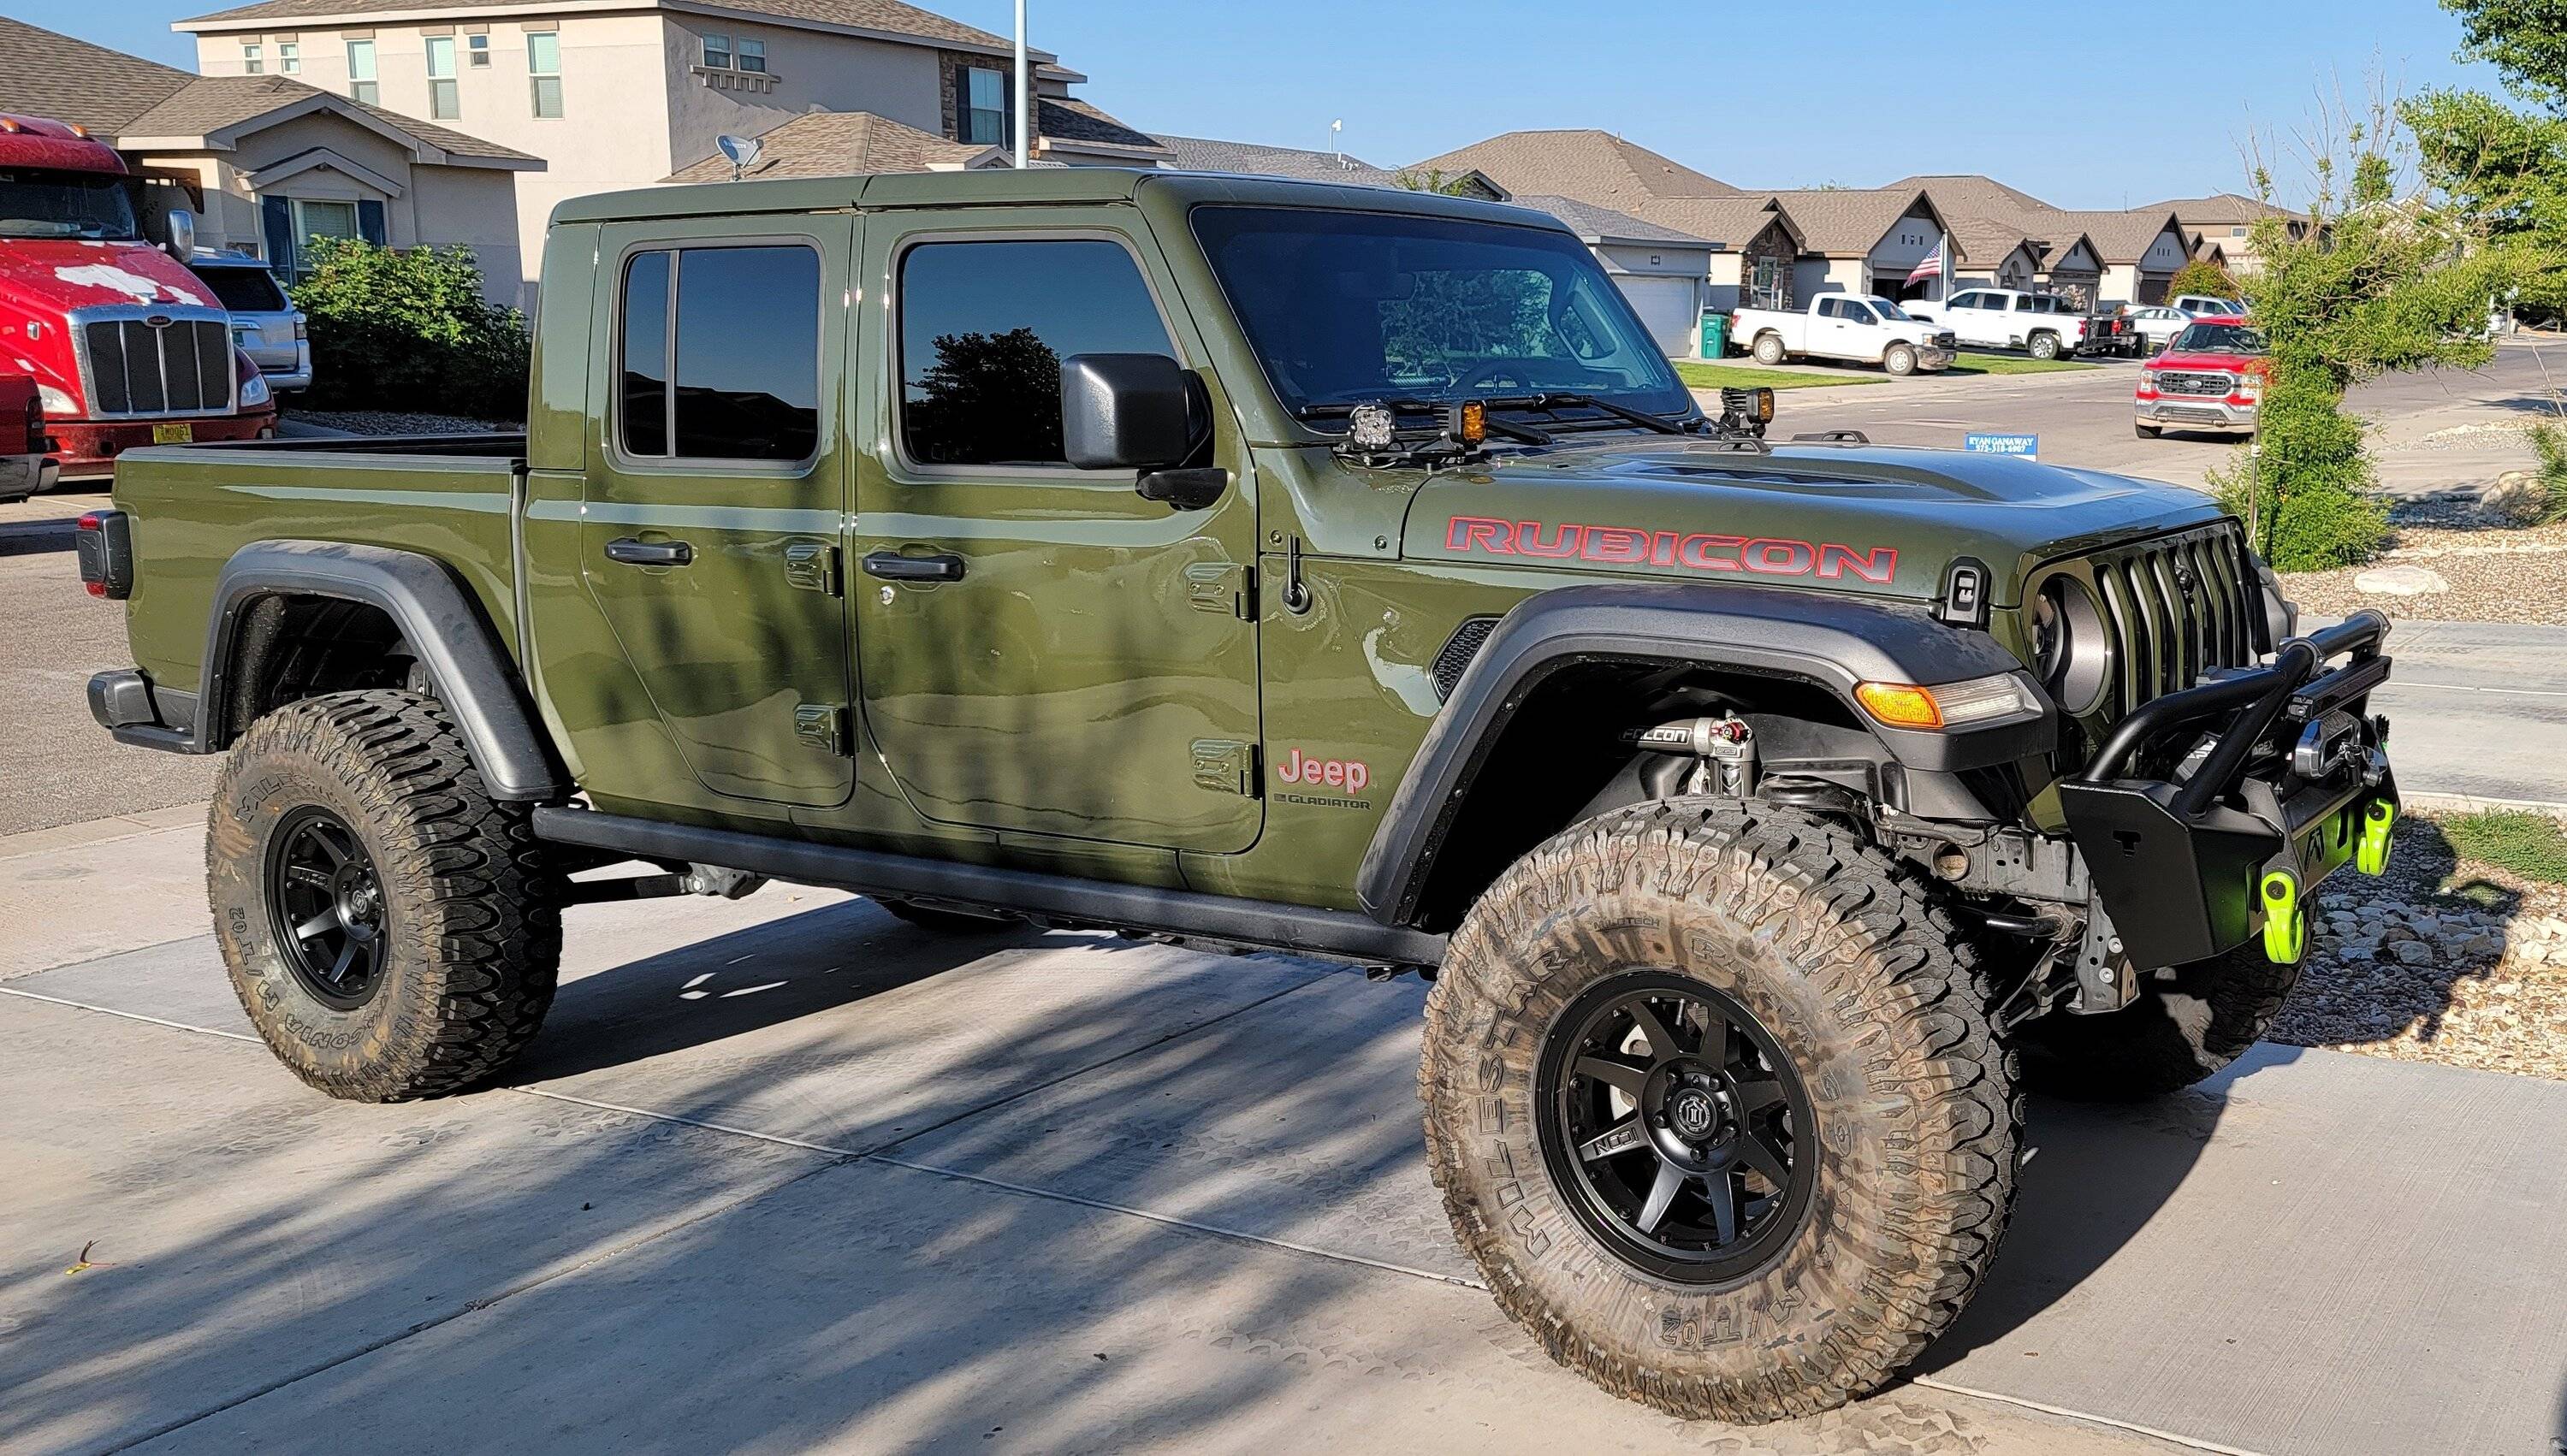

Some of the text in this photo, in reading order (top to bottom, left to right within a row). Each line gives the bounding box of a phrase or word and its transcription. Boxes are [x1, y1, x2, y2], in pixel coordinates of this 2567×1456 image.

[1968, 436, 1991, 446] RYAN
[1446, 517, 1899, 583] RUBICON
[1621, 727, 1687, 743] FALCON
[1278, 747, 1369, 796] Jeep
[1288, 795, 1372, 810] GLADIATOR
[1475, 946, 1569, 1260] MILESTAR
